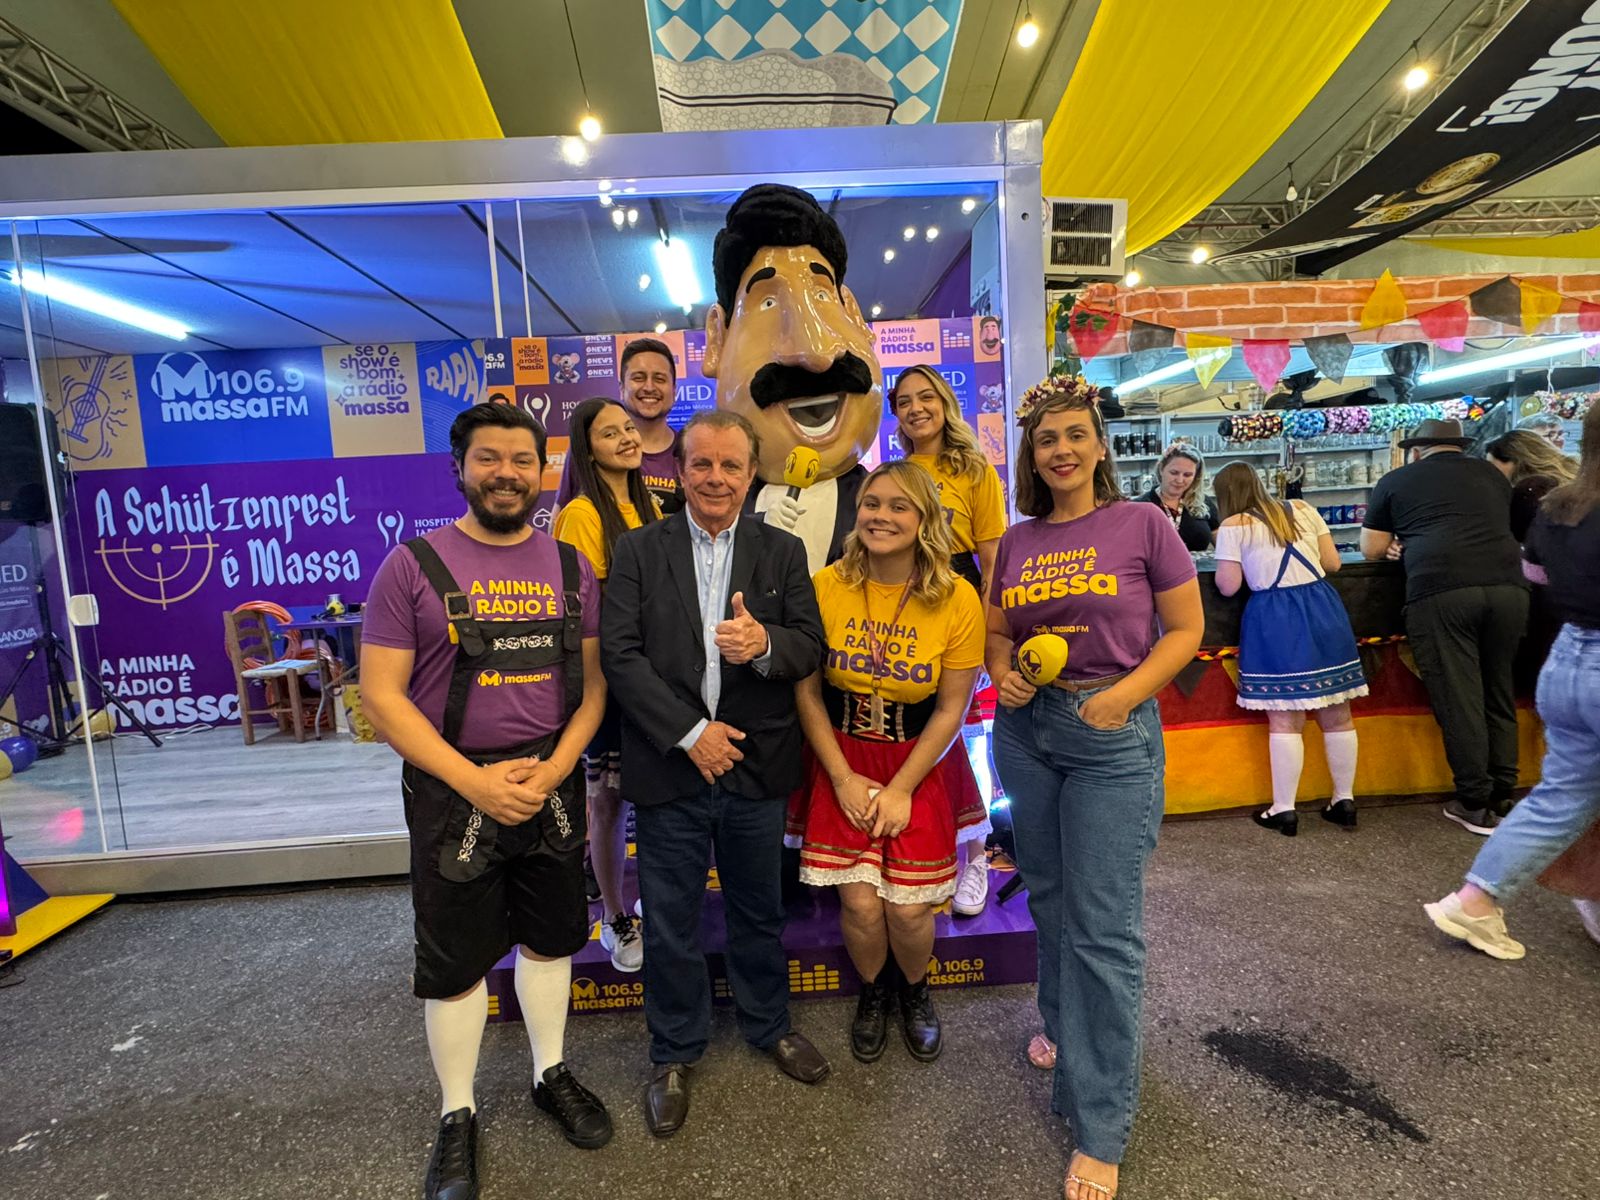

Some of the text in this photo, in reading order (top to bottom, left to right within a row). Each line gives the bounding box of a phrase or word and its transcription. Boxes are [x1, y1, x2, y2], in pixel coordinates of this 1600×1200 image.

[881, 334, 908, 343] RÁDIO
[355, 345, 389, 356] se o
[881, 342, 935, 354] massa
[340, 352, 400, 369] show é
[357, 363, 396, 379] bom
[216, 368, 305, 396] 106.9
[343, 380, 408, 397] a rádio
[344, 400, 410, 416] massa
[642, 475, 677, 489] INHA
[95, 476, 356, 544] A Schützenfest
[414, 517, 459, 528] HOSPITA
[220, 537, 361, 588] é Massa
[1021, 546, 1097, 569] A MINHA
[0, 564, 28, 583] ED
[1020, 558, 1096, 582] RÁDIO É
[470, 579, 555, 597] A MINHA
[1001, 573, 1118, 610] massa
[476, 595, 558, 615] RÁDIO É
[845, 617, 918, 640] A MINHA
[906, 641, 917, 658] É
[101, 653, 196, 675] A MINHA
[827, 648, 933, 684] massa
[102, 672, 192, 697] RÁDIO É
[943, 958, 985, 972] 106.9
[601, 983, 644, 997] 106.9
